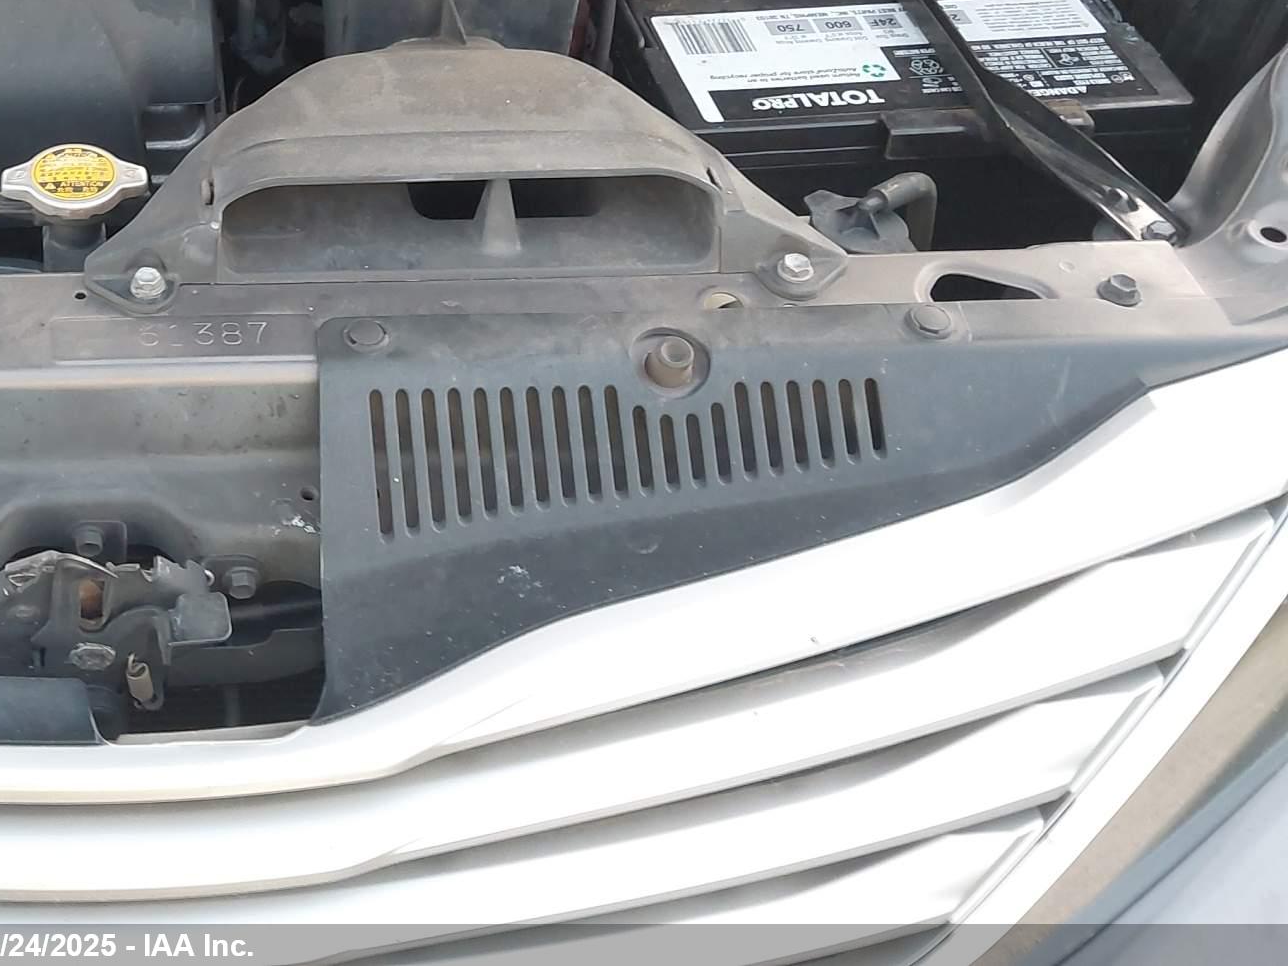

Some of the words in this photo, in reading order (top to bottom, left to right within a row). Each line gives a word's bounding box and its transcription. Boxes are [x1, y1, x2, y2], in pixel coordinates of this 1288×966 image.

[824, 20, 852, 30] 600
[869, 17, 897, 27] 24F
[776, 23, 805, 33] 750
[751, 89, 886, 111] TOTALPRO
